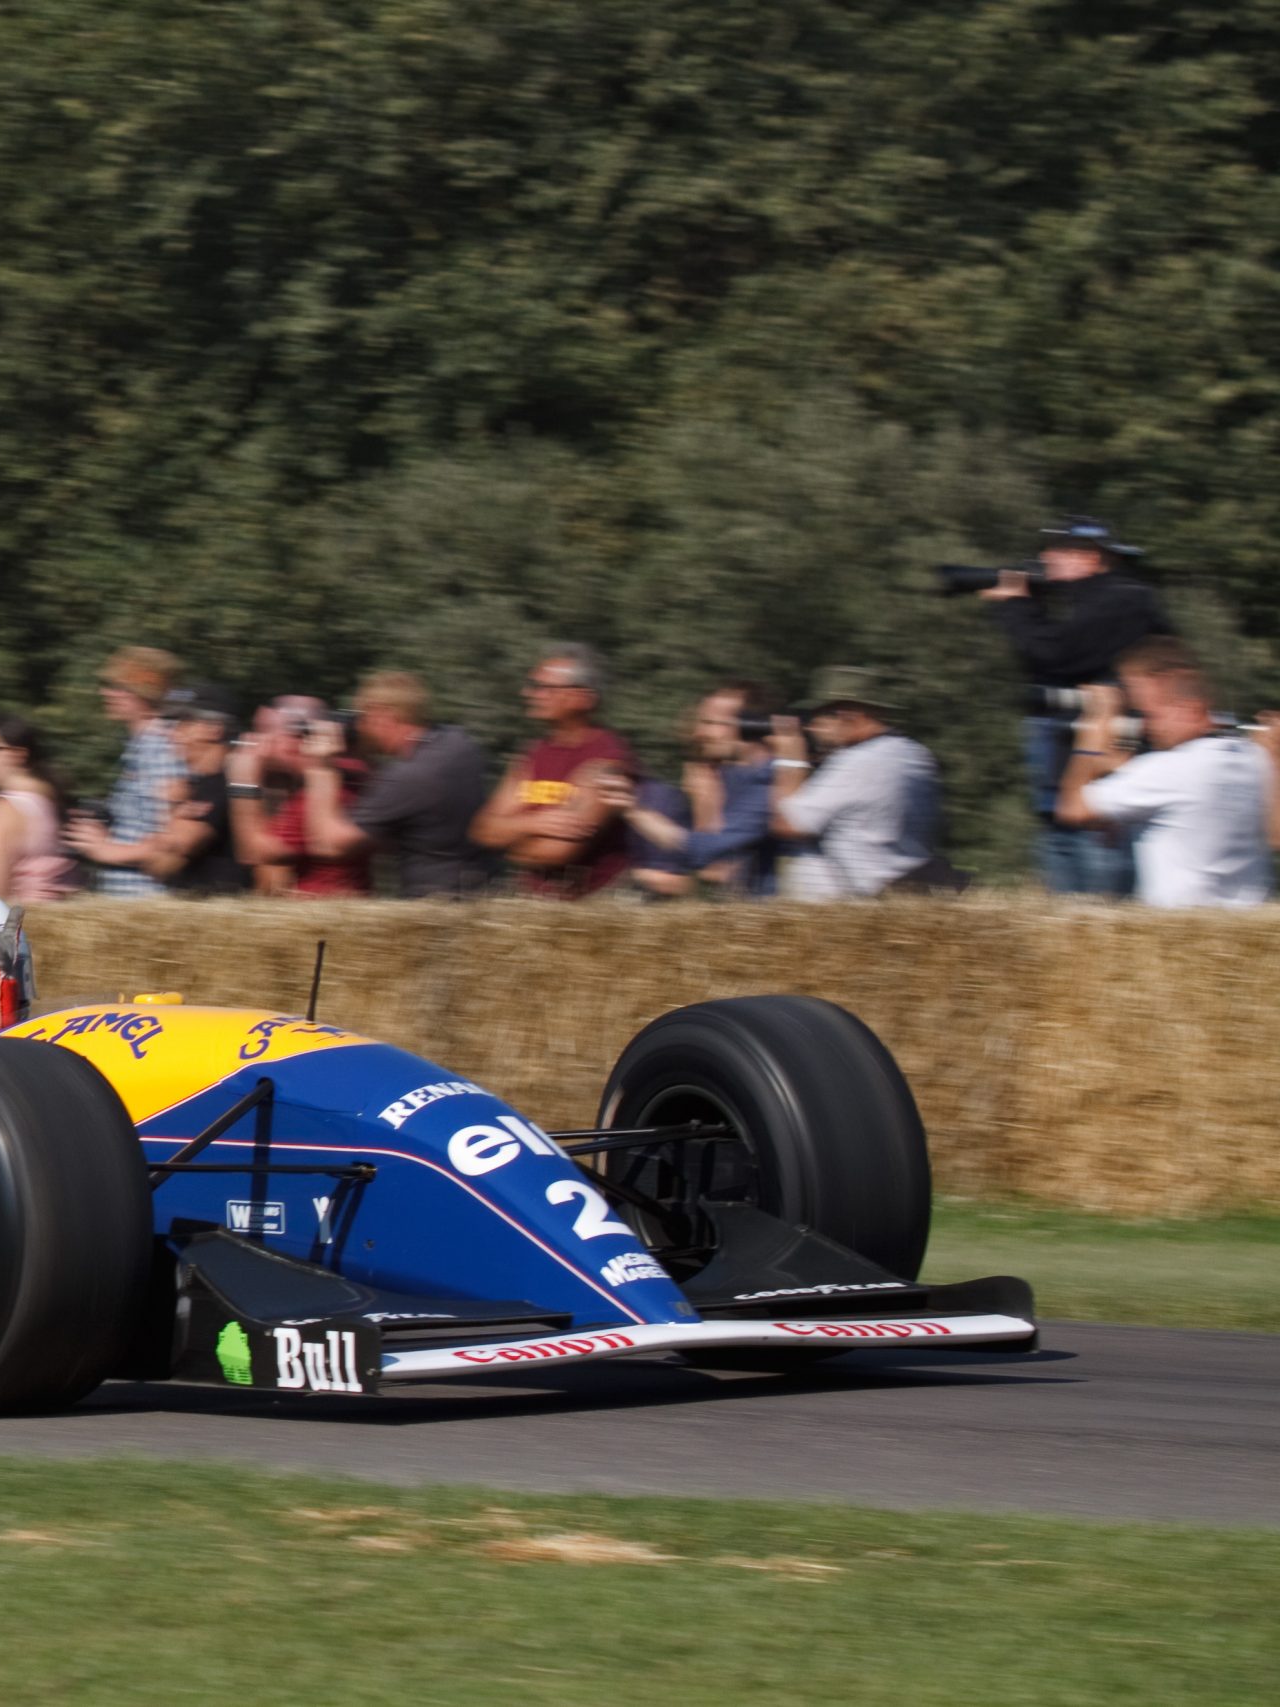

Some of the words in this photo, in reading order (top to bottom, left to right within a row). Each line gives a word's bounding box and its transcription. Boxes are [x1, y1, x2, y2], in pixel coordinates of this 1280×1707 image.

[545, 1179, 635, 1240] 2
[452, 1333, 635, 1363] Canon
[771, 1322, 951, 1337] Canon
[273, 1327, 363, 1393] Bull
